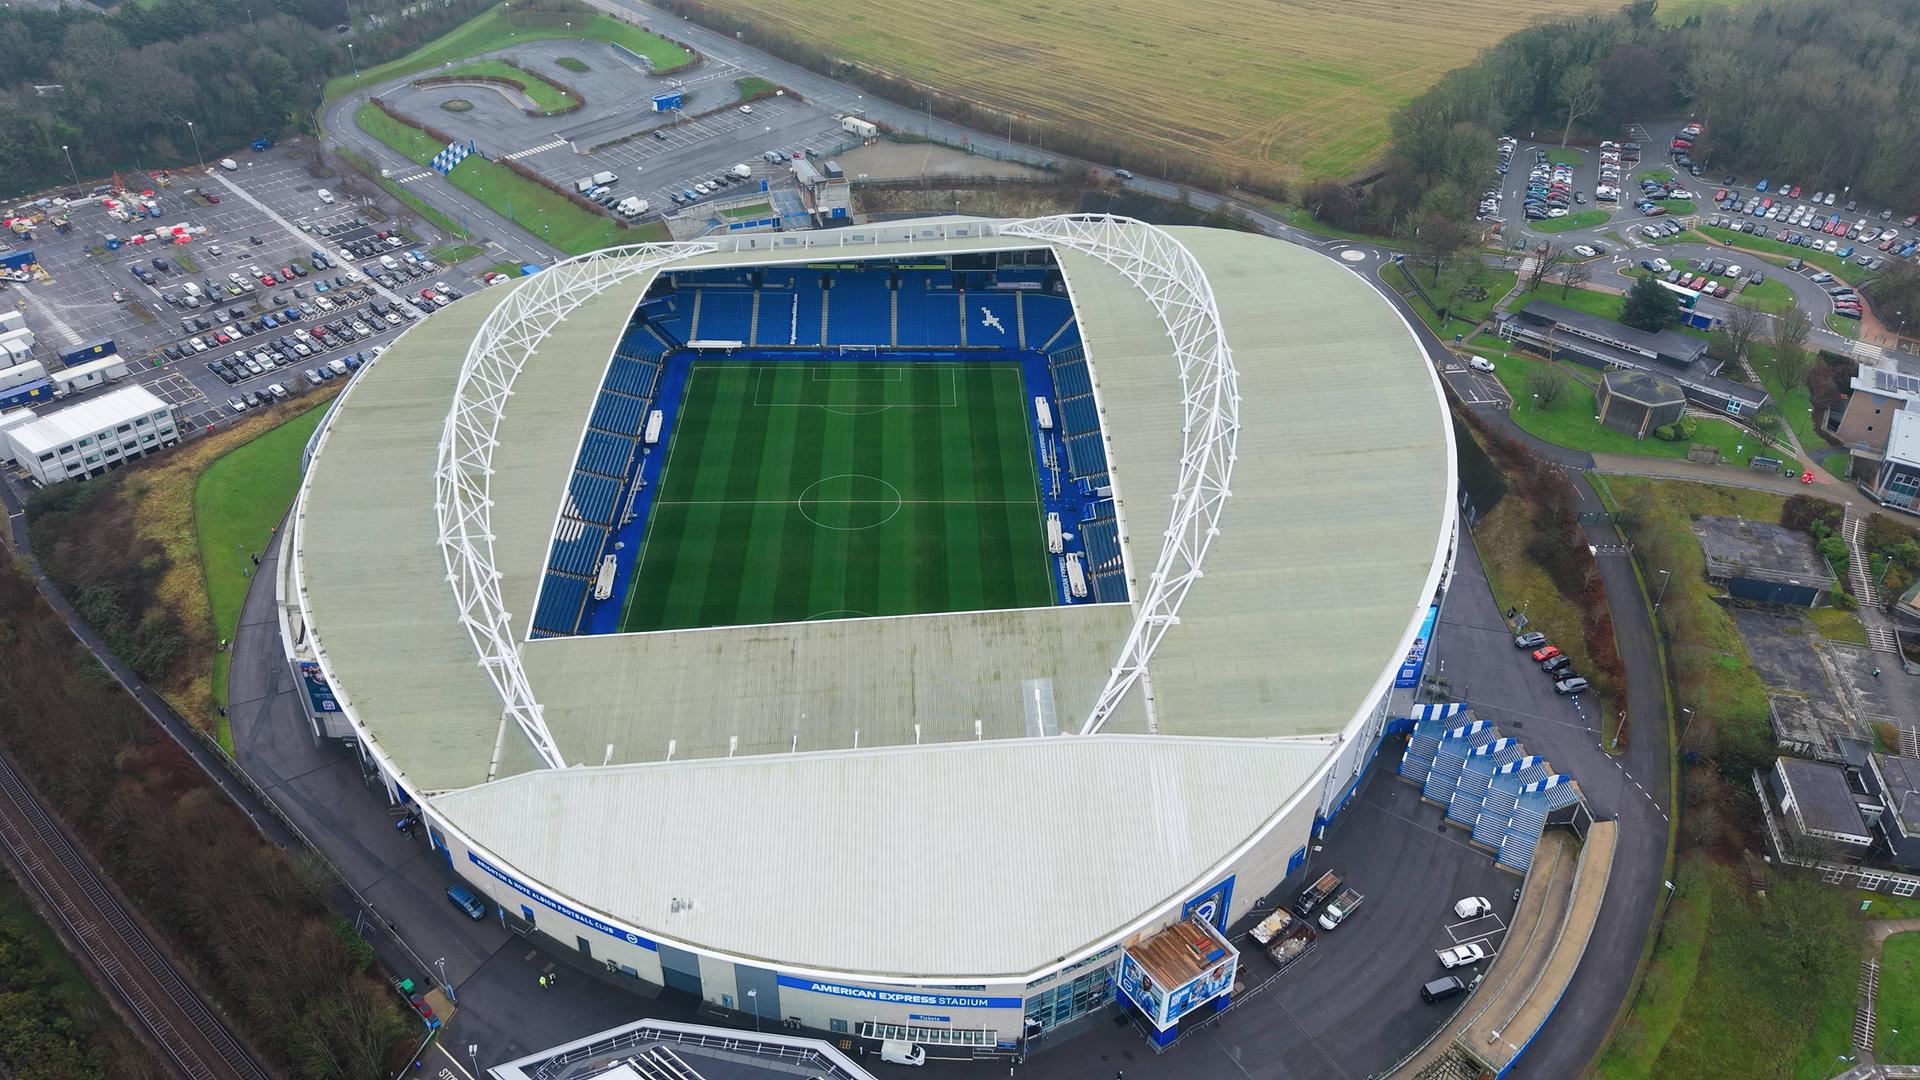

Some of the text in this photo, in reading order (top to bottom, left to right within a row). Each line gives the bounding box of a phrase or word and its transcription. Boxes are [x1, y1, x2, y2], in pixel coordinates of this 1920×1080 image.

[1062, 578, 1072, 604] AMERICAN
[477, 859, 507, 881] BRIGHTON
[513, 881, 531, 895] HOVE
[531, 892, 557, 909] ALBION
[557, 904, 595, 927] FOOTBALL
[595, 922, 614, 935] CLUB
[811, 983, 988, 1007] AMERICAN EXPRESS STADIUM
[438, 1068, 458, 1080] STO
